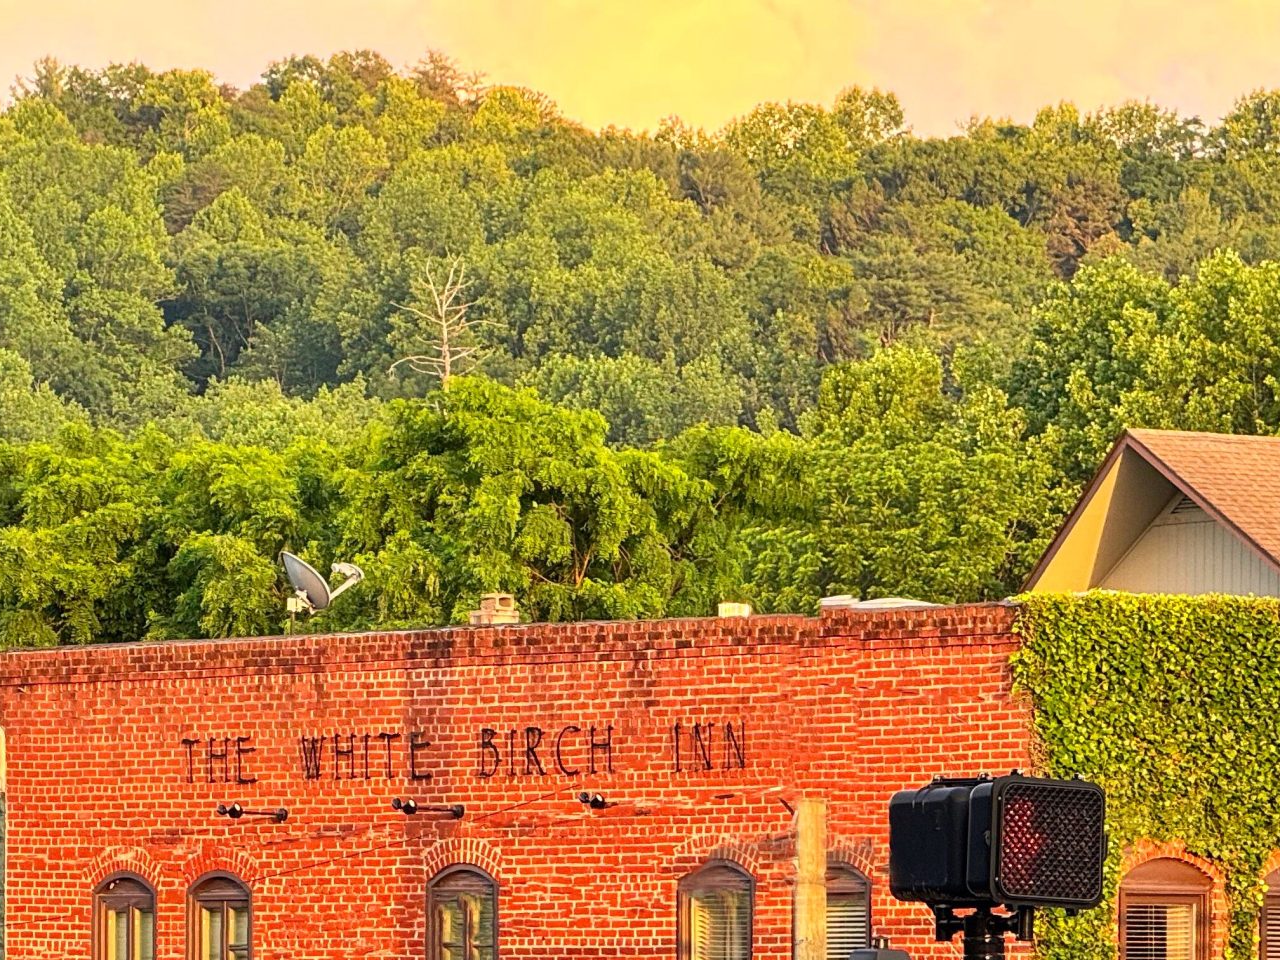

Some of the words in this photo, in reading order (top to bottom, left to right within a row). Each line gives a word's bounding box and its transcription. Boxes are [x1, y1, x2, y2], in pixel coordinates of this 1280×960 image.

[181, 735, 258, 785] THE
[301, 731, 432, 781] WHITE
[478, 724, 615, 778] BIRCH
[672, 721, 746, 773] INN
